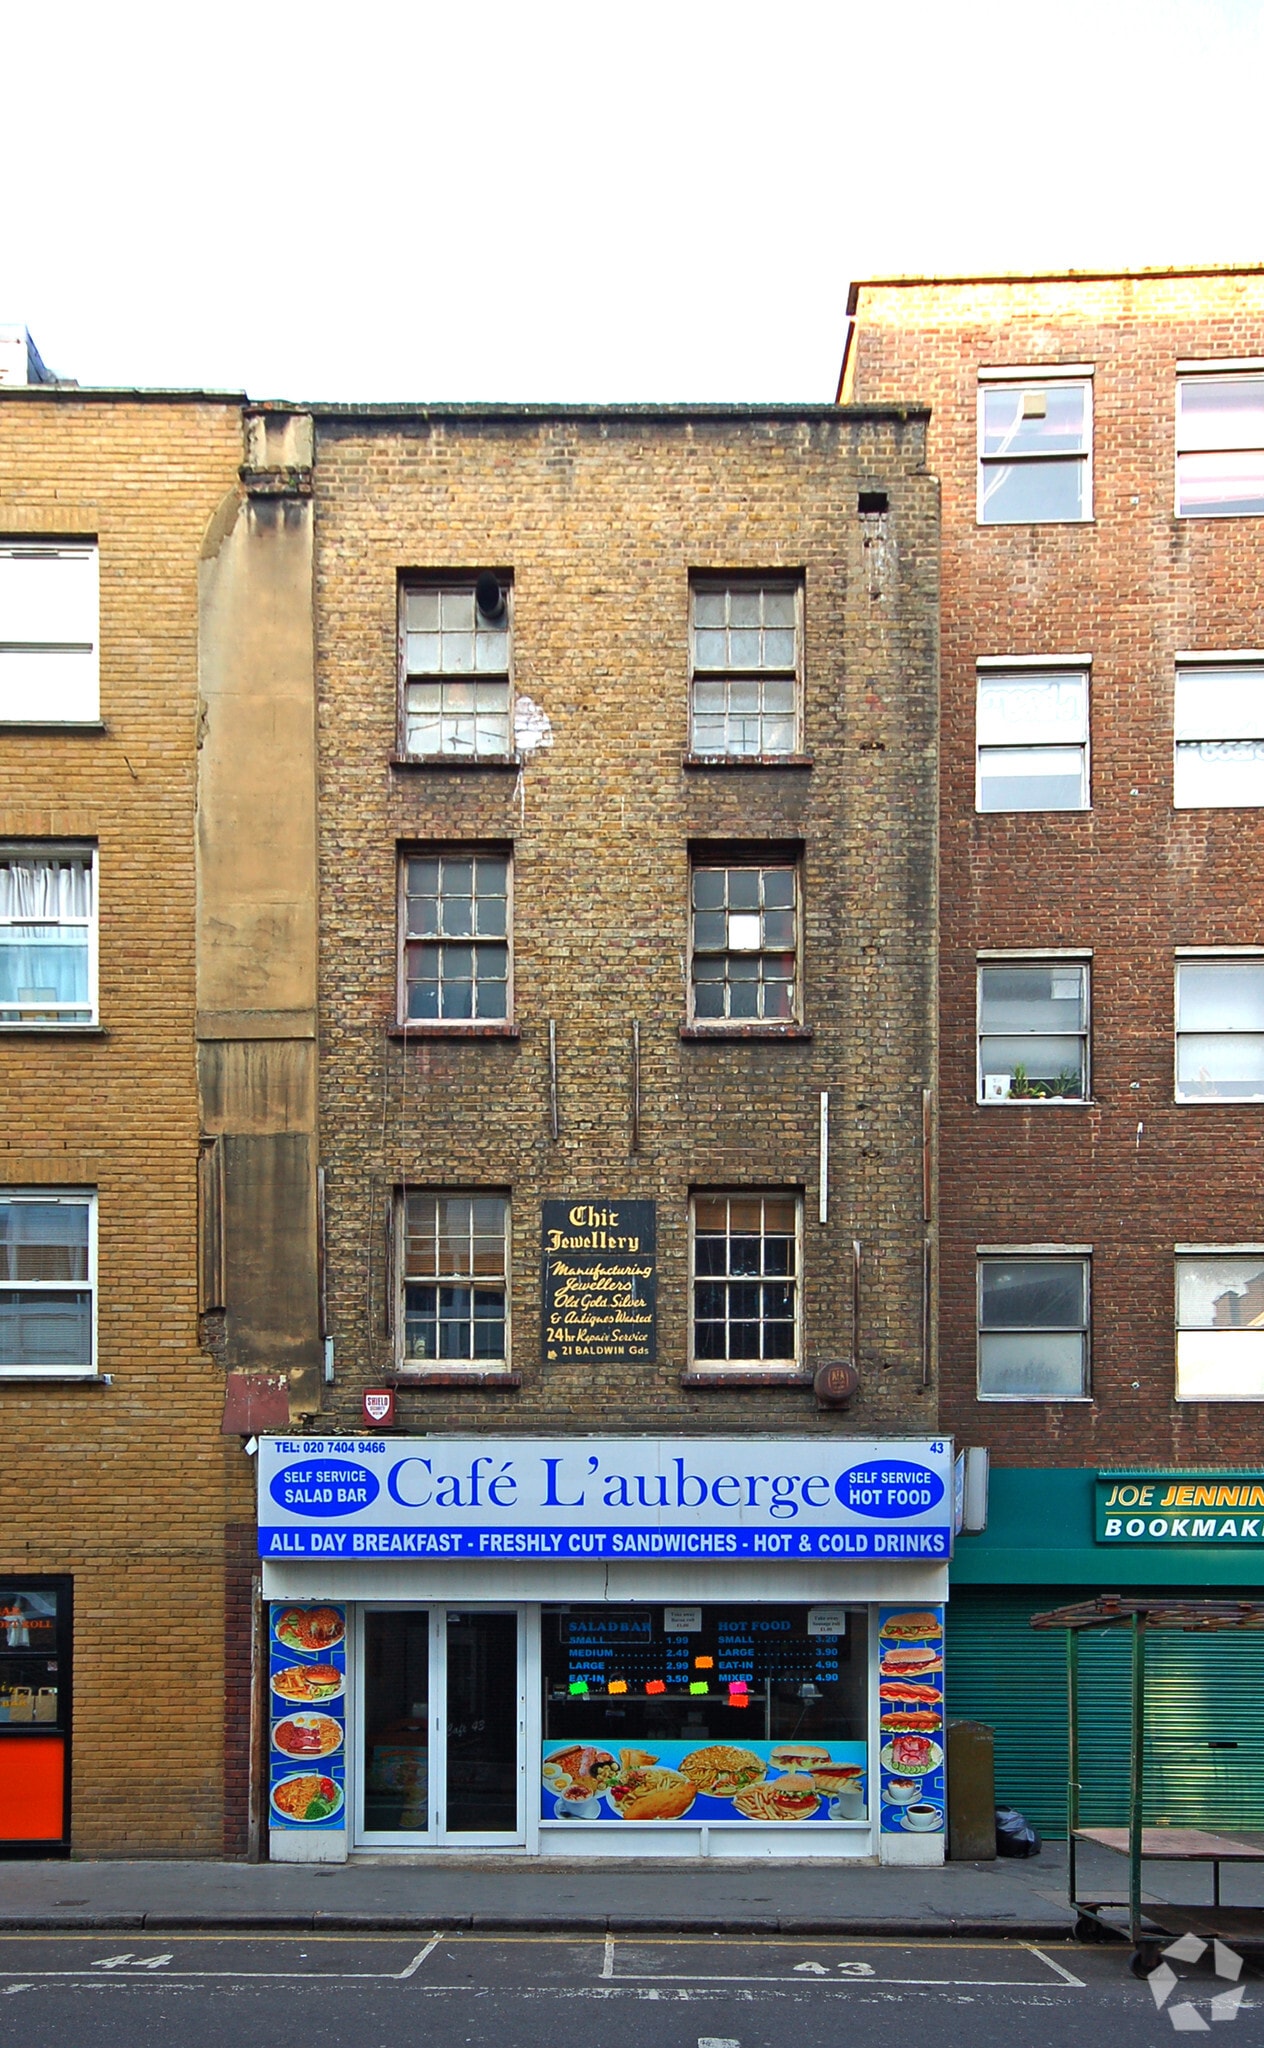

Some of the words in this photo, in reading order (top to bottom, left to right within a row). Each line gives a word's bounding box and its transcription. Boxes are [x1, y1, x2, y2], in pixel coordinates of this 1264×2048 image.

[569, 1206, 619, 1227] Chic
[545, 1229, 639, 1252] Jewellery
[549, 1261, 652, 1280] Manufacturing
[554, 1277, 632, 1297] Jewellers
[554, 1295, 578, 1308] Old
[581, 1294, 608, 1311] Gold
[610, 1294, 647, 1308] Silver
[551, 1313, 561, 1324] &
[577, 1329, 608, 1344] Repair
[611, 1329, 648, 1342] Service
[562, 1347, 572, 1355] 21
[576, 1347, 624, 1355] BALDWIN
[629, 1346, 649, 1355] Gds
[275, 1443, 300, 1453] TEL:
[304, 1443, 323, 1453] 020
[328, 1442, 354, 1453] 7404
[359, 1442, 385, 1453] 9466
[930, 1443, 943, 1454] 43
[285, 1472, 311, 1483] SELF
[316, 1471, 366, 1482] SERVICE
[387, 1458, 518, 1507] Café
[849, 1472, 877, 1483] SELF
[881, 1472, 931, 1483] SERVICE
[285, 1490, 332, 1503] SALAD
[338, 1489, 366, 1502] BAR
[850, 1490, 882, 1505] HOT
[888, 1490, 931, 1505] FOOD
[1105, 1485, 1155, 1506] JOE
[270, 1534, 304, 1551] ALL
[311, 1534, 346, 1551] DAY
[353, 1534, 462, 1551] BREAKFAST
[480, 1534, 562, 1552] FRESHLY
[568, 1534, 606, 1552] CUT
[612, 1534, 736, 1552] SANDWICHES
[754, 1534, 792, 1552] HOT
[799, 1534, 811, 1552] &
[819, 1534, 868, 1552] COLD
[874, 1534, 944, 1552] DRINKS
[569, 1622, 618, 1632] SALAD
[621, 1622, 651, 1631] BAR
[719, 1622, 748, 1631] HOT
[752, 1621, 791, 1631] FOOD
[816, 1635, 837, 1643] 3.20
[91, 1953, 174, 1969] 44
[793, 1961, 876, 1976] 43
